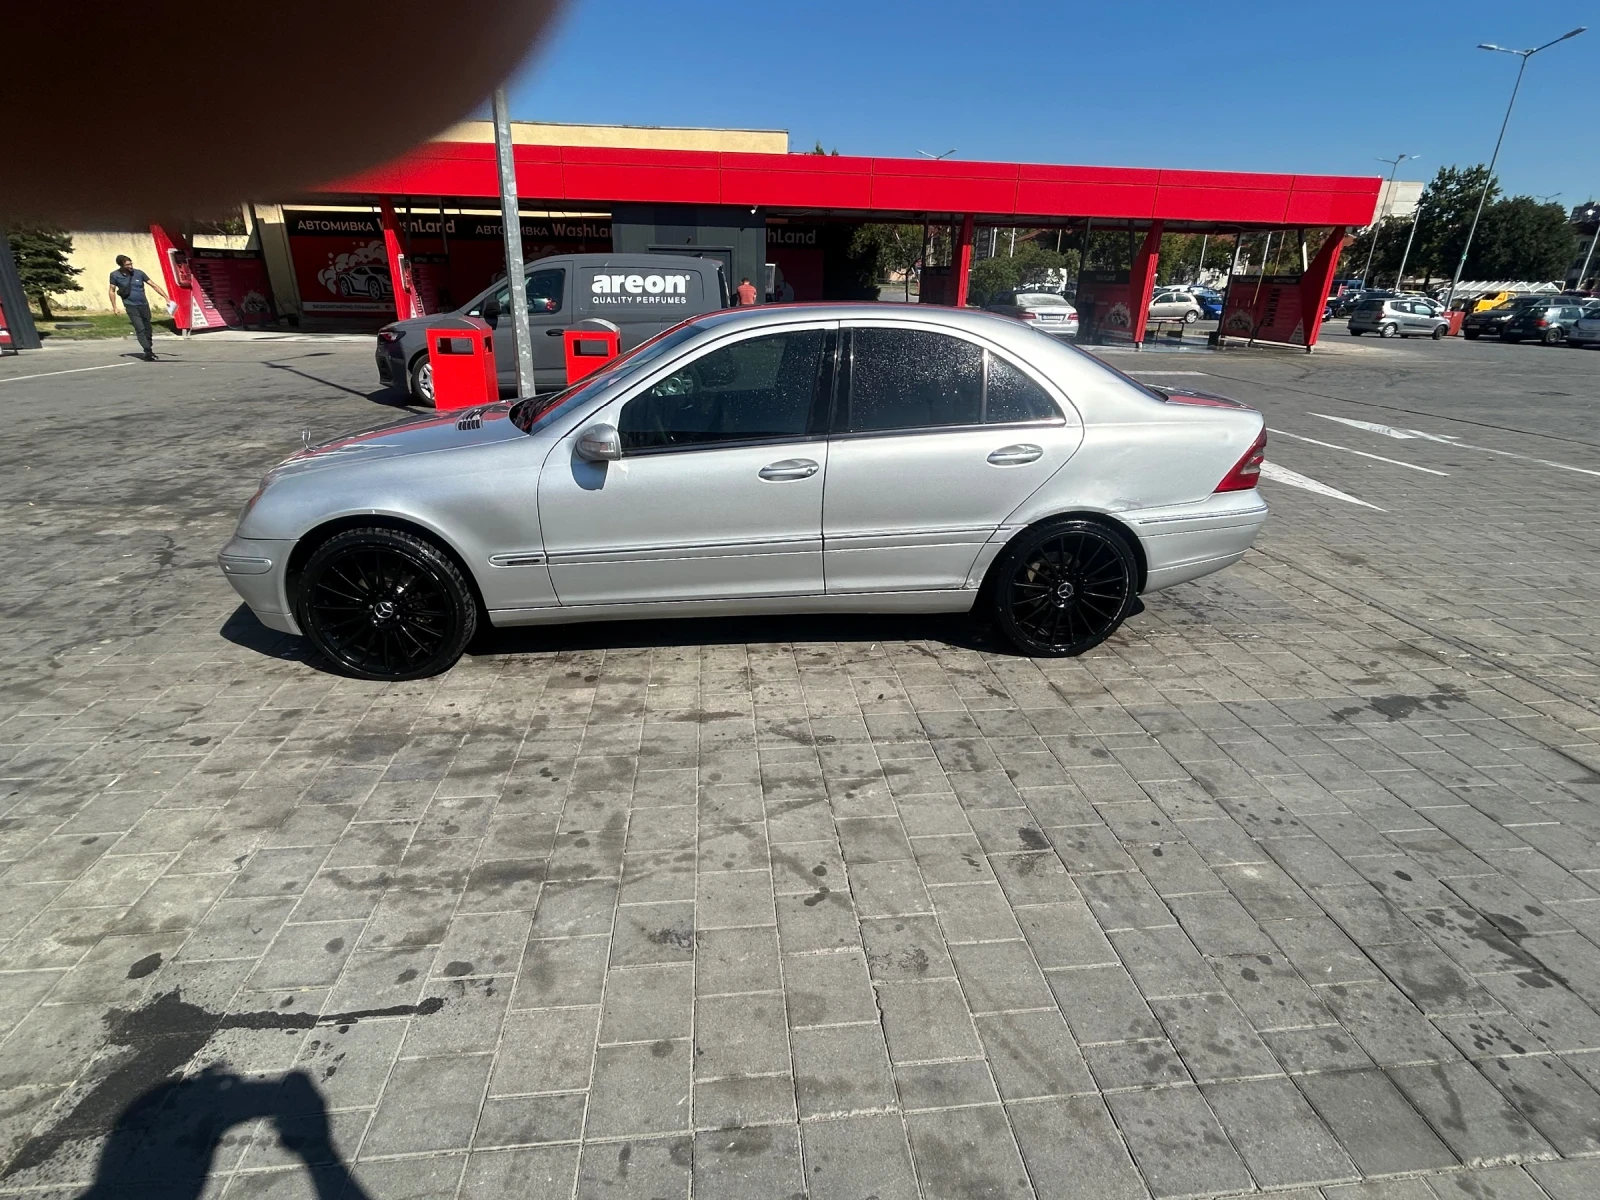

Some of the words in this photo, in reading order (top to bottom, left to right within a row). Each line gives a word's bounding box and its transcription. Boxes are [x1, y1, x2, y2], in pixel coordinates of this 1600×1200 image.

[297, 219, 374, 232] АВТОМИВКА
[475, 224, 549, 237] АВТОИВКА
[592, 296, 633, 304] QUALITY
[636, 296, 687, 304] PERFUMES
